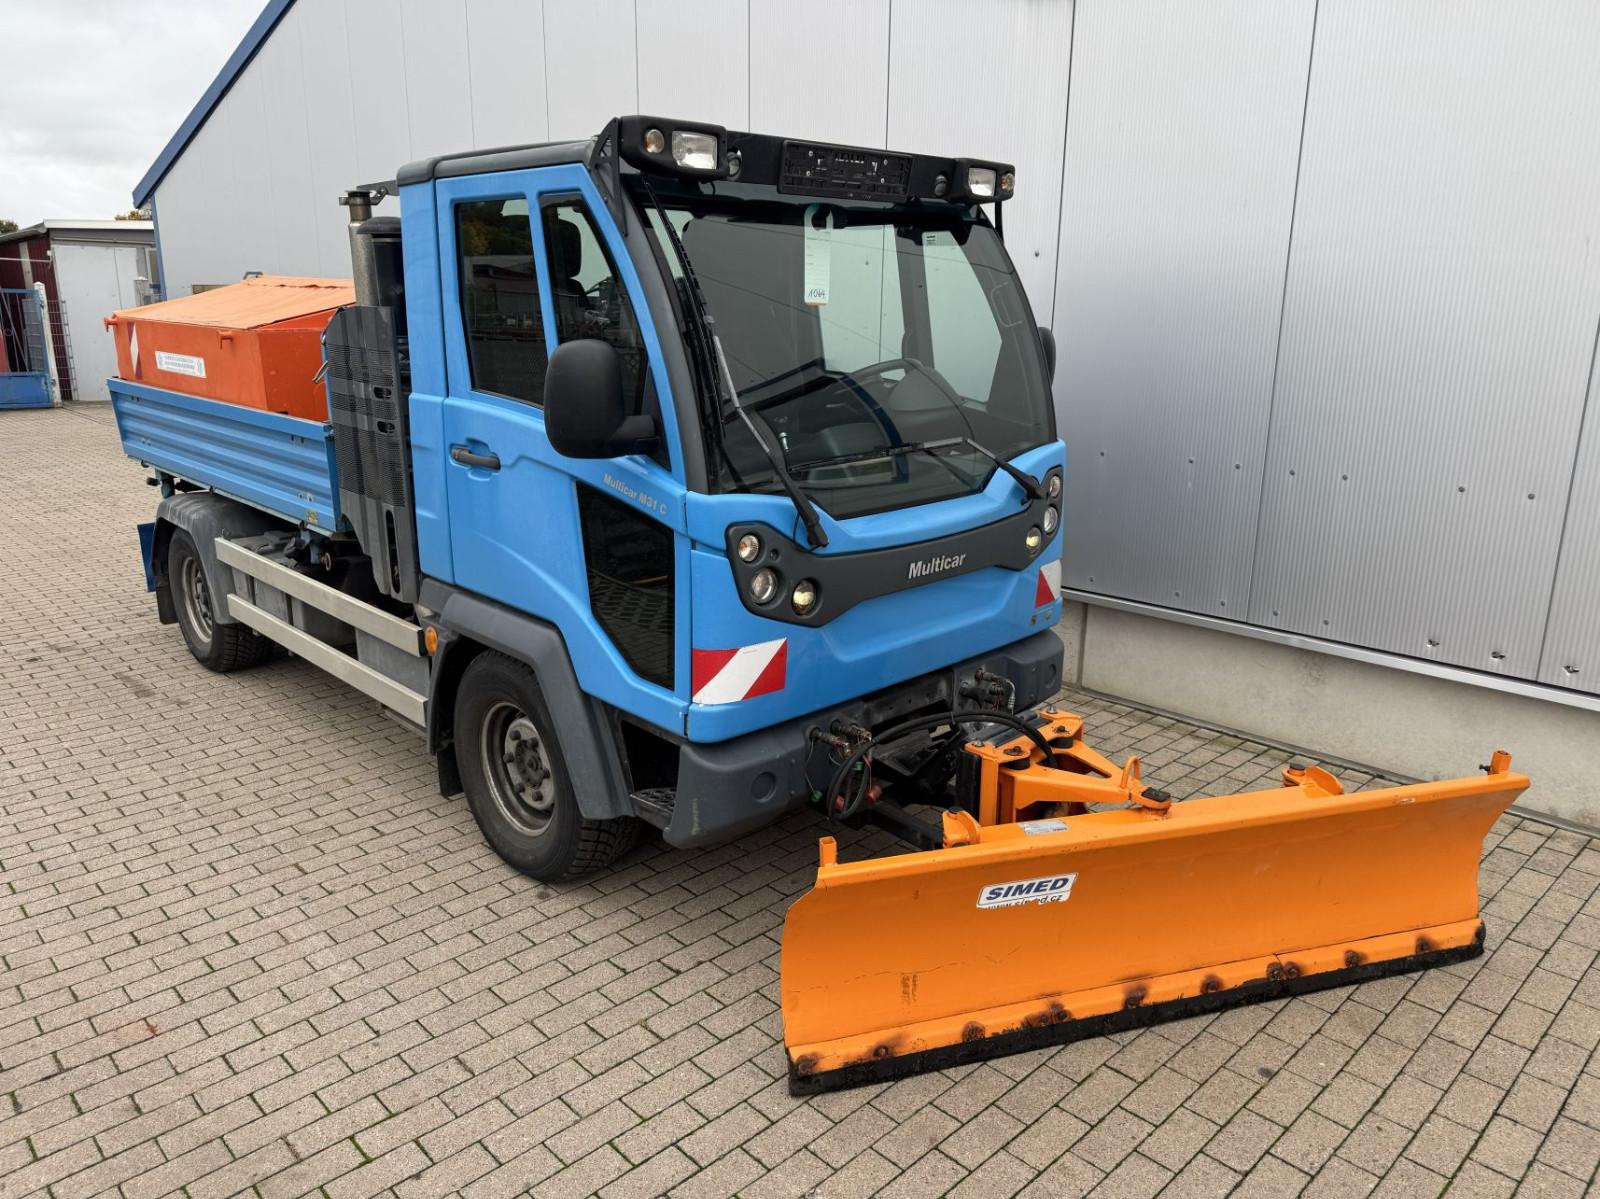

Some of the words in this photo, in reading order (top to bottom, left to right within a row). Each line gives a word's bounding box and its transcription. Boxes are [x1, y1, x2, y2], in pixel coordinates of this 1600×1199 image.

[603, 472, 637, 499] Multicar
[659, 503, 667, 514] C
[908, 553, 966, 579] Multicar
[986, 877, 1069, 900] SIMED
